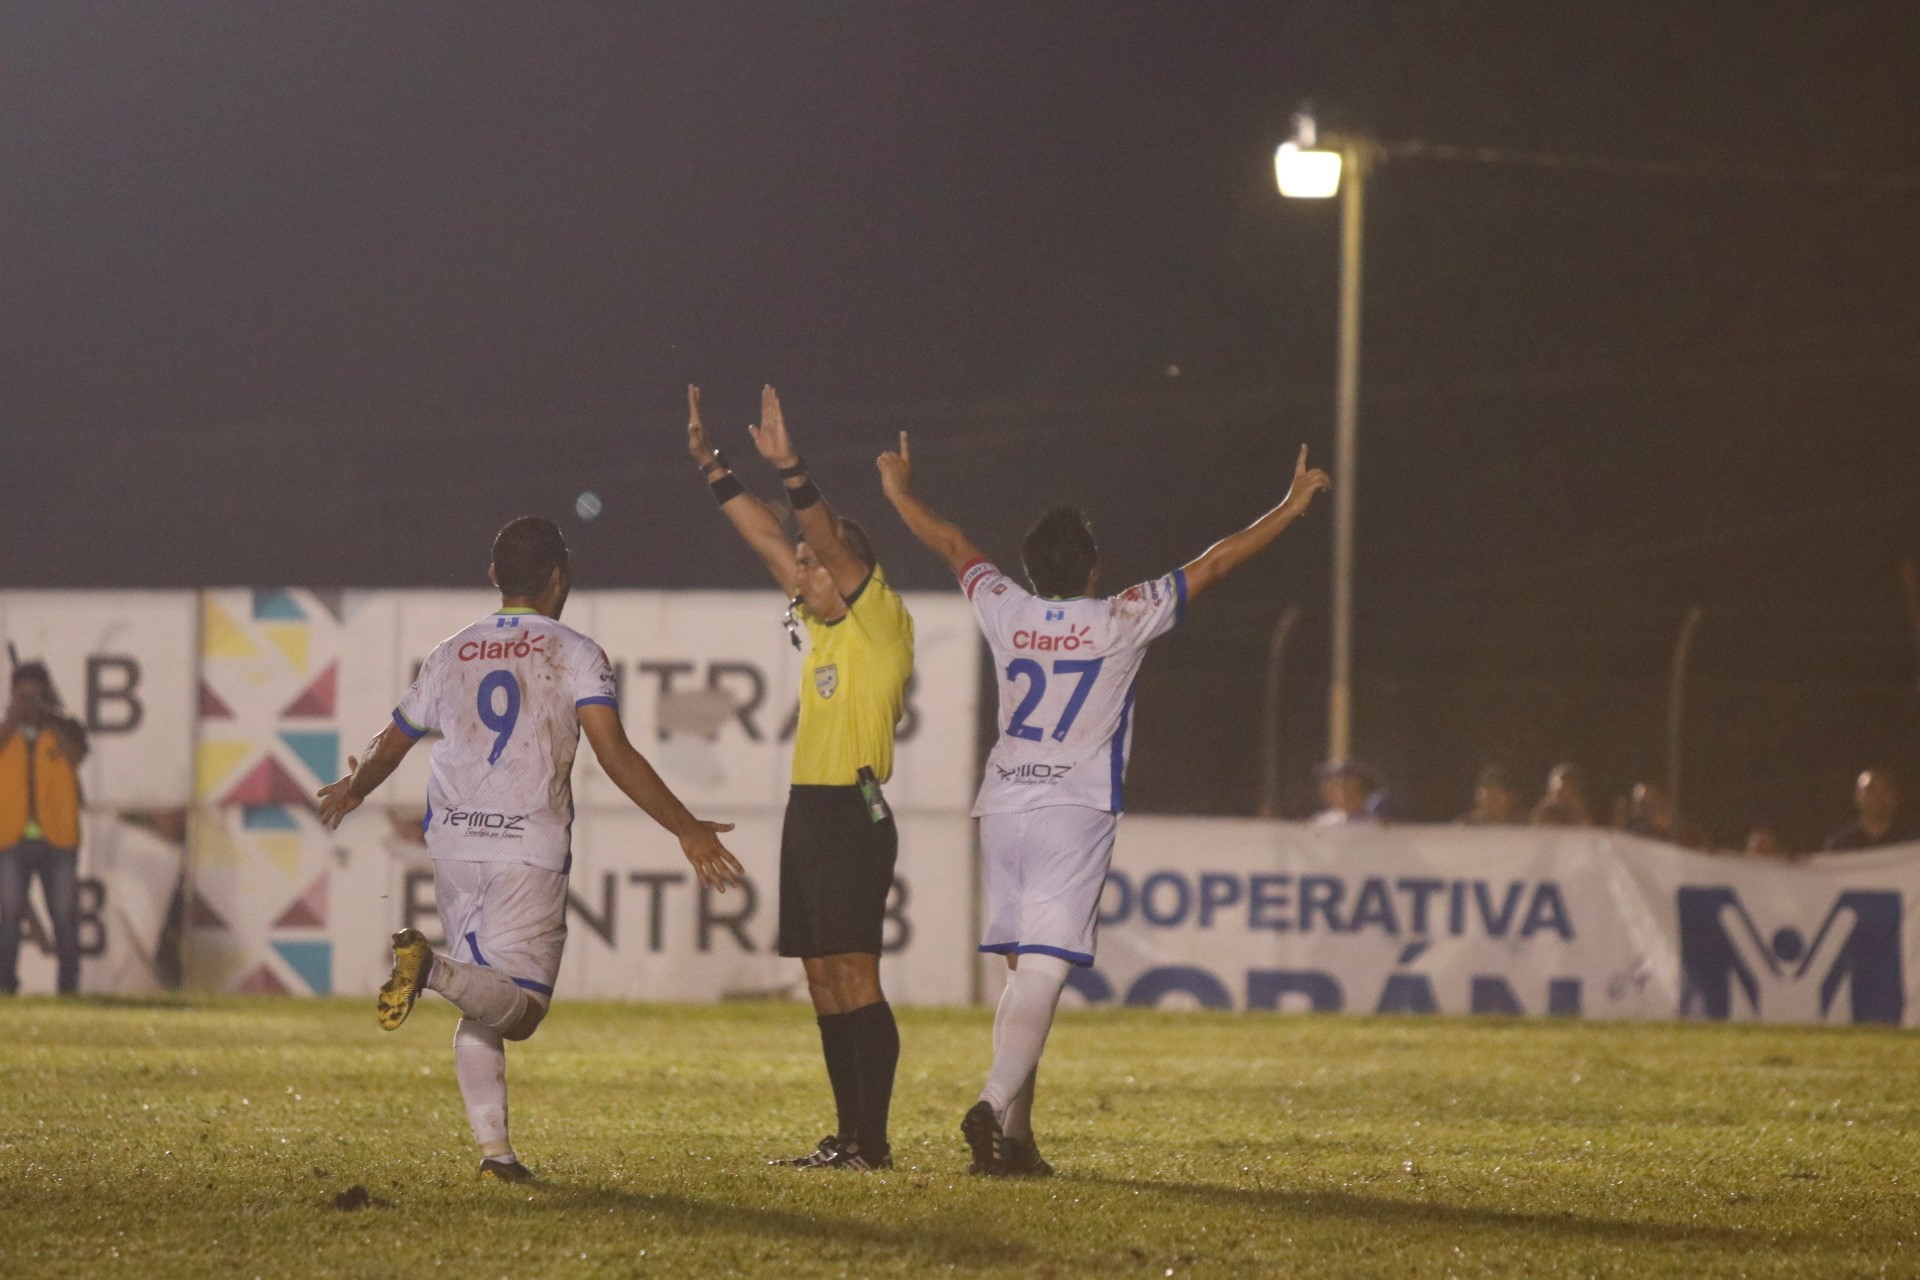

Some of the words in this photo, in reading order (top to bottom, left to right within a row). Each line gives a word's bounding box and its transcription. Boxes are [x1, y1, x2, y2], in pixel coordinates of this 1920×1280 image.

[458, 637, 535, 661] Claro
[1013, 628, 1083, 651] Claro
[477, 669, 521, 765] 9
[1006, 657, 1105, 743] 27
[1100, 870, 1574, 941] OOPERATIVA
